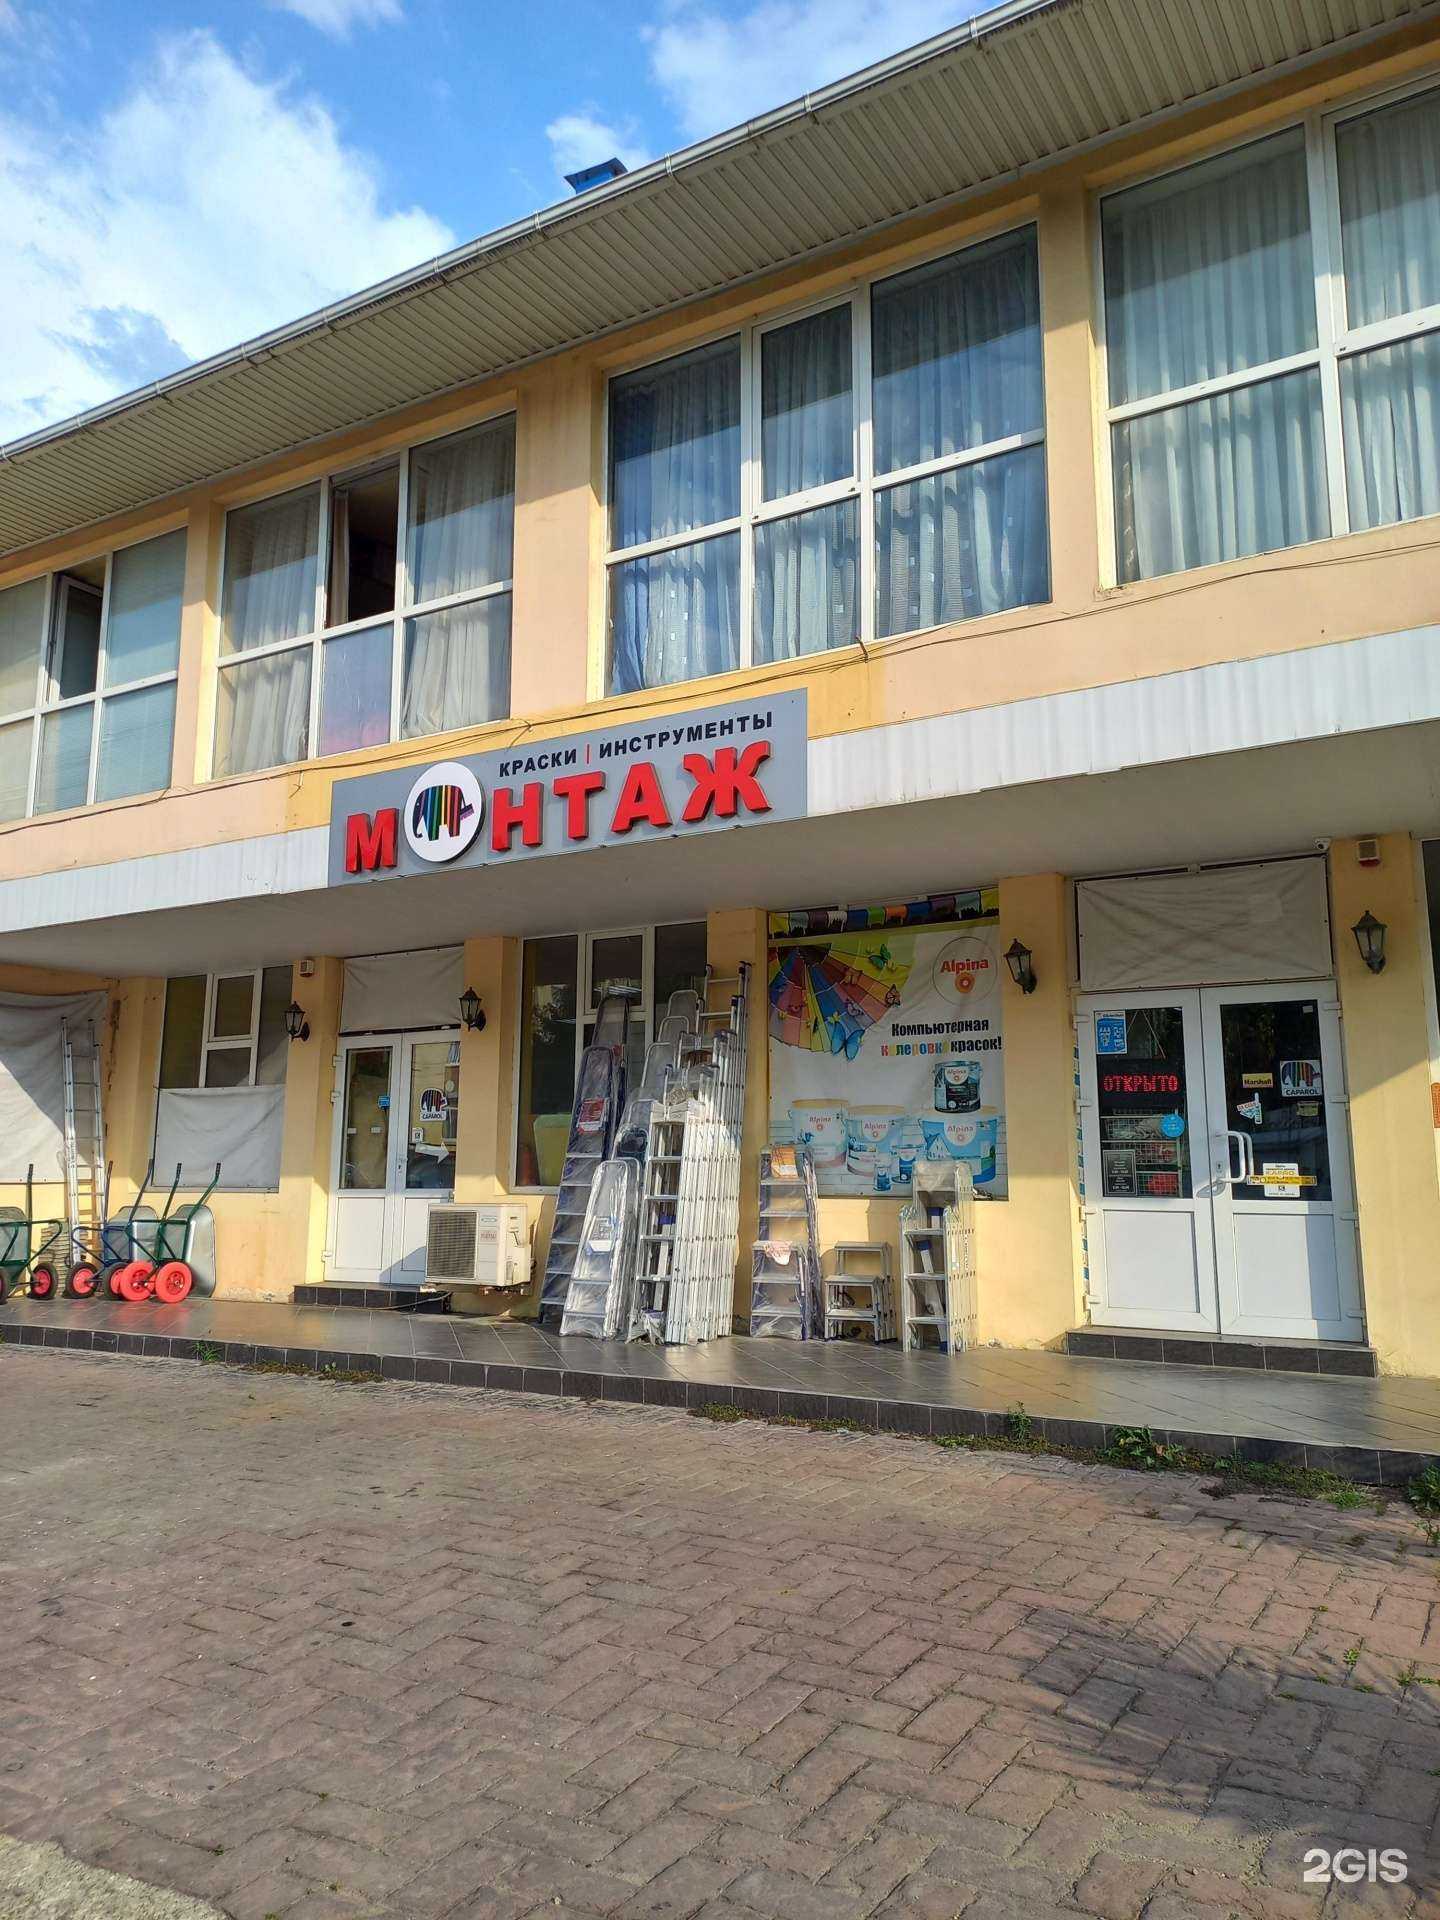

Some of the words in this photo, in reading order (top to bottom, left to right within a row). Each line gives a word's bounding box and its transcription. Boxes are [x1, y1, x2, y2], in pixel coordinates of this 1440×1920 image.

[499, 748, 577, 777] КРАСКИ
[599, 711, 773, 759] ИНСТРУМЕНТЫ
[940, 957, 989, 974] Alpina
[891, 1019, 989, 1036] Компьютерная
[950, 1036, 1002, 1053] красок!
[1103, 1074, 1179, 1092] ОТКРЫТО
